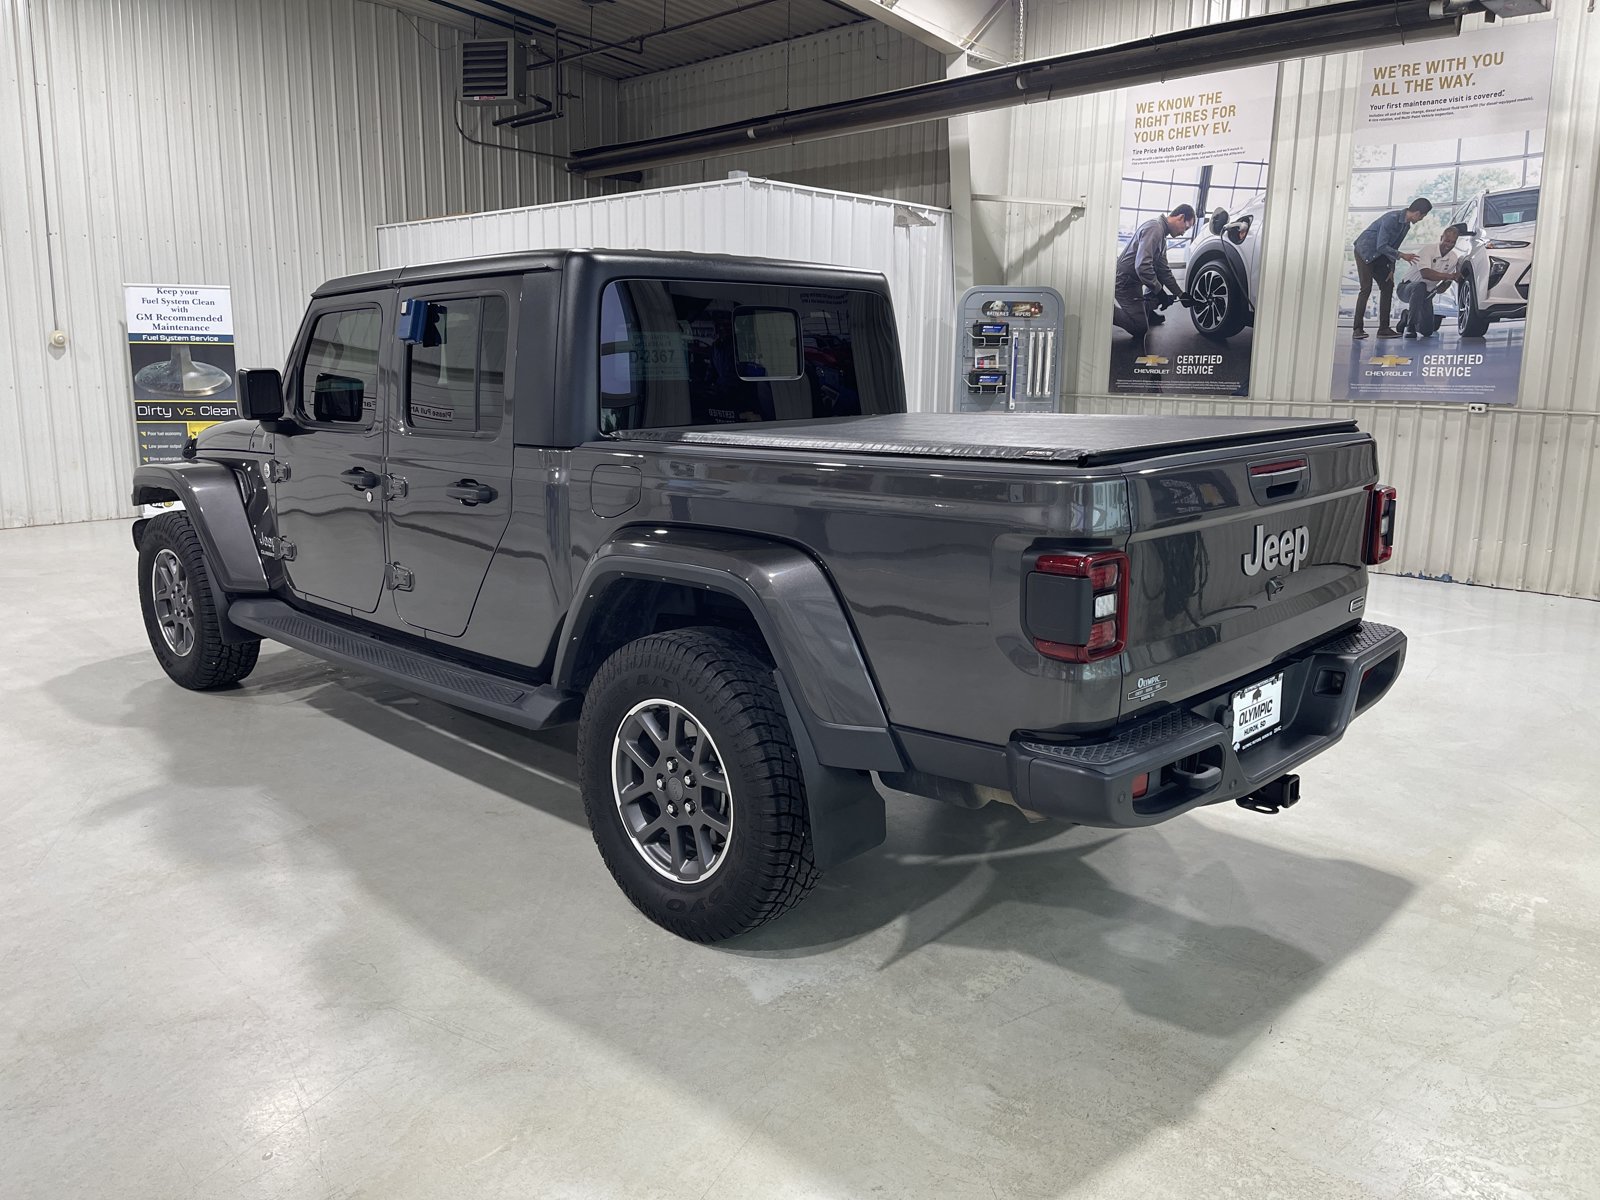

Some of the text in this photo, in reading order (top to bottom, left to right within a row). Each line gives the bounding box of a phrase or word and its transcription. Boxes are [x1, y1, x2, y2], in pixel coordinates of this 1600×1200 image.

[1374, 52, 1504, 80] WE'RE WITH YOU
[1370, 72, 1476, 96] ALL THE WAY.
[1136, 92, 1222, 114] WE KNOW THE
[1402, 98, 1447, 108] maintenance
[1135, 105, 1236, 129] RIGHT TIRES FOR
[1134, 121, 1232, 143] YOUR CHEVY EV.
[156, 287, 177, 296] Keep
[161, 298, 190, 306] System
[156, 314, 223, 322] Recommended
[152, 323, 210, 332] Maintenance
[1176, 355, 1222, 364] CERTIFIED
[1423, 354, 1483, 365] CERTIFIED
[1176, 366, 1214, 374] SERVICE
[1422, 366, 1472, 377] SERVICE
[138, 406, 237, 417] Dirty vs. Clean
[1242, 524, 1309, 576] Jeep
[1239, 700, 1272, 726] OLYMPIC
